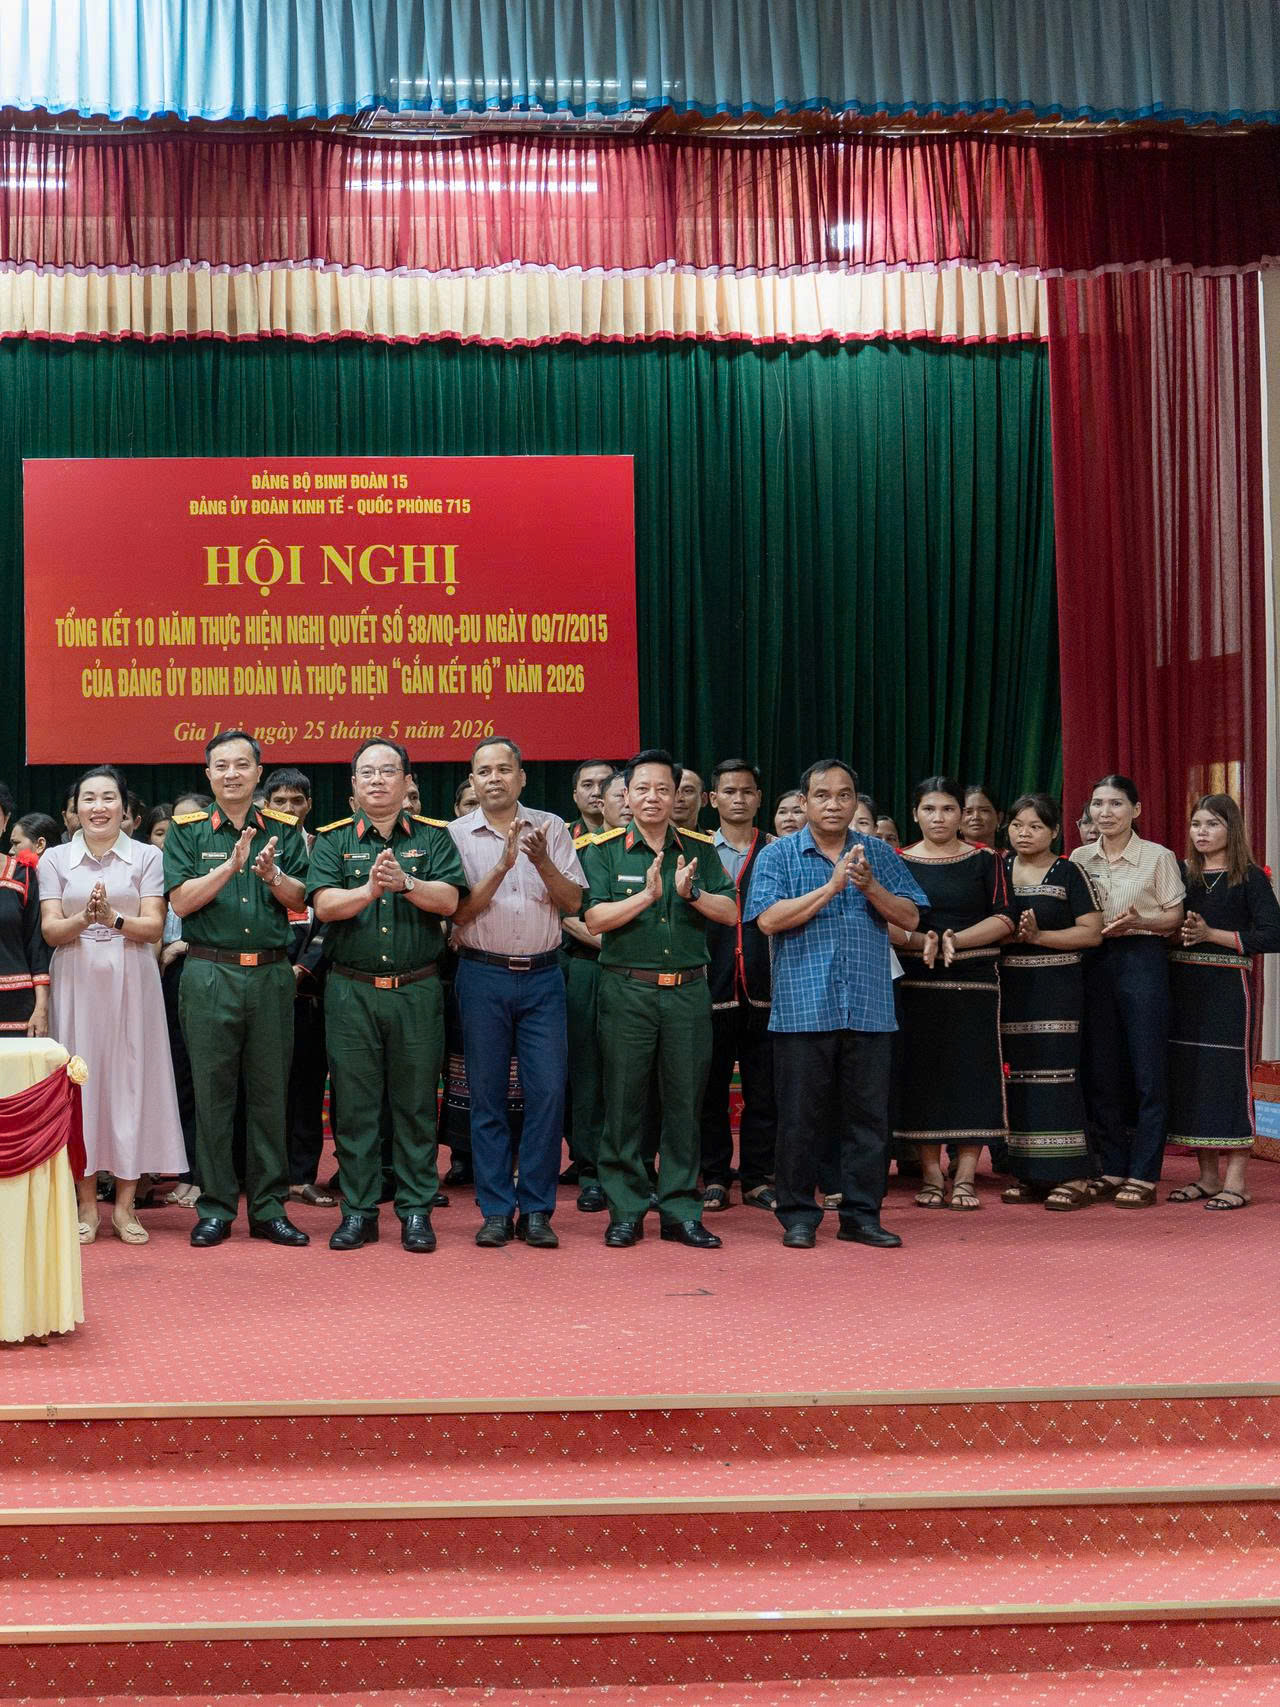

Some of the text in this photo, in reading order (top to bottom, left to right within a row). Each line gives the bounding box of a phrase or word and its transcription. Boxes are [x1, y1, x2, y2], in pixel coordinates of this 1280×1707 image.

[252, 469, 408, 492] ĐẢNG BỘ BINH ĐOÀN 15
[189, 495, 227, 515] ĐẢNG
[231, 494, 248, 514] ỦY
[251, 496, 289, 514] ĐOÀN
[292, 499, 325, 514] KINH
[328, 494, 344, 514] TẾ
[357, 493, 393, 516] QUỐC
[397, 495, 442, 514] PHÒNG
[446, 499, 471, 514] 715
[202, 538, 460, 597] HỘI NGHỊ
[55, 604, 608, 651] TỔNG KẾT 10 NĂM THỰC HIỆN NGHỊ QUYẾT SỐ 38/NQ-ĐU NGÀY 09/7/2015
[81, 658, 114, 697] CỦA
[118, 658, 162, 697] ĐẢNG
[166, 657, 187, 696] ỦY
[191, 667, 230, 696] BINH
[233, 660, 277, 696] ĐOÀN
[281, 659, 303, 695] VÀ
[306, 662, 347, 701] THỰC
[351, 658, 389, 701] HIỆN
[438, 655, 467, 694] KẾT
[506, 658, 542, 693] NĂM
[546, 664, 585, 693] 2026
[174, 721, 207, 741] Gia
[253, 720, 298, 745] ngày
[303, 720, 325, 740] 25
[330, 720, 384, 740] tháng
[388, 720, 400, 739] 5
[404, 720, 445, 739] năm
[450, 719, 495, 738] 2026
